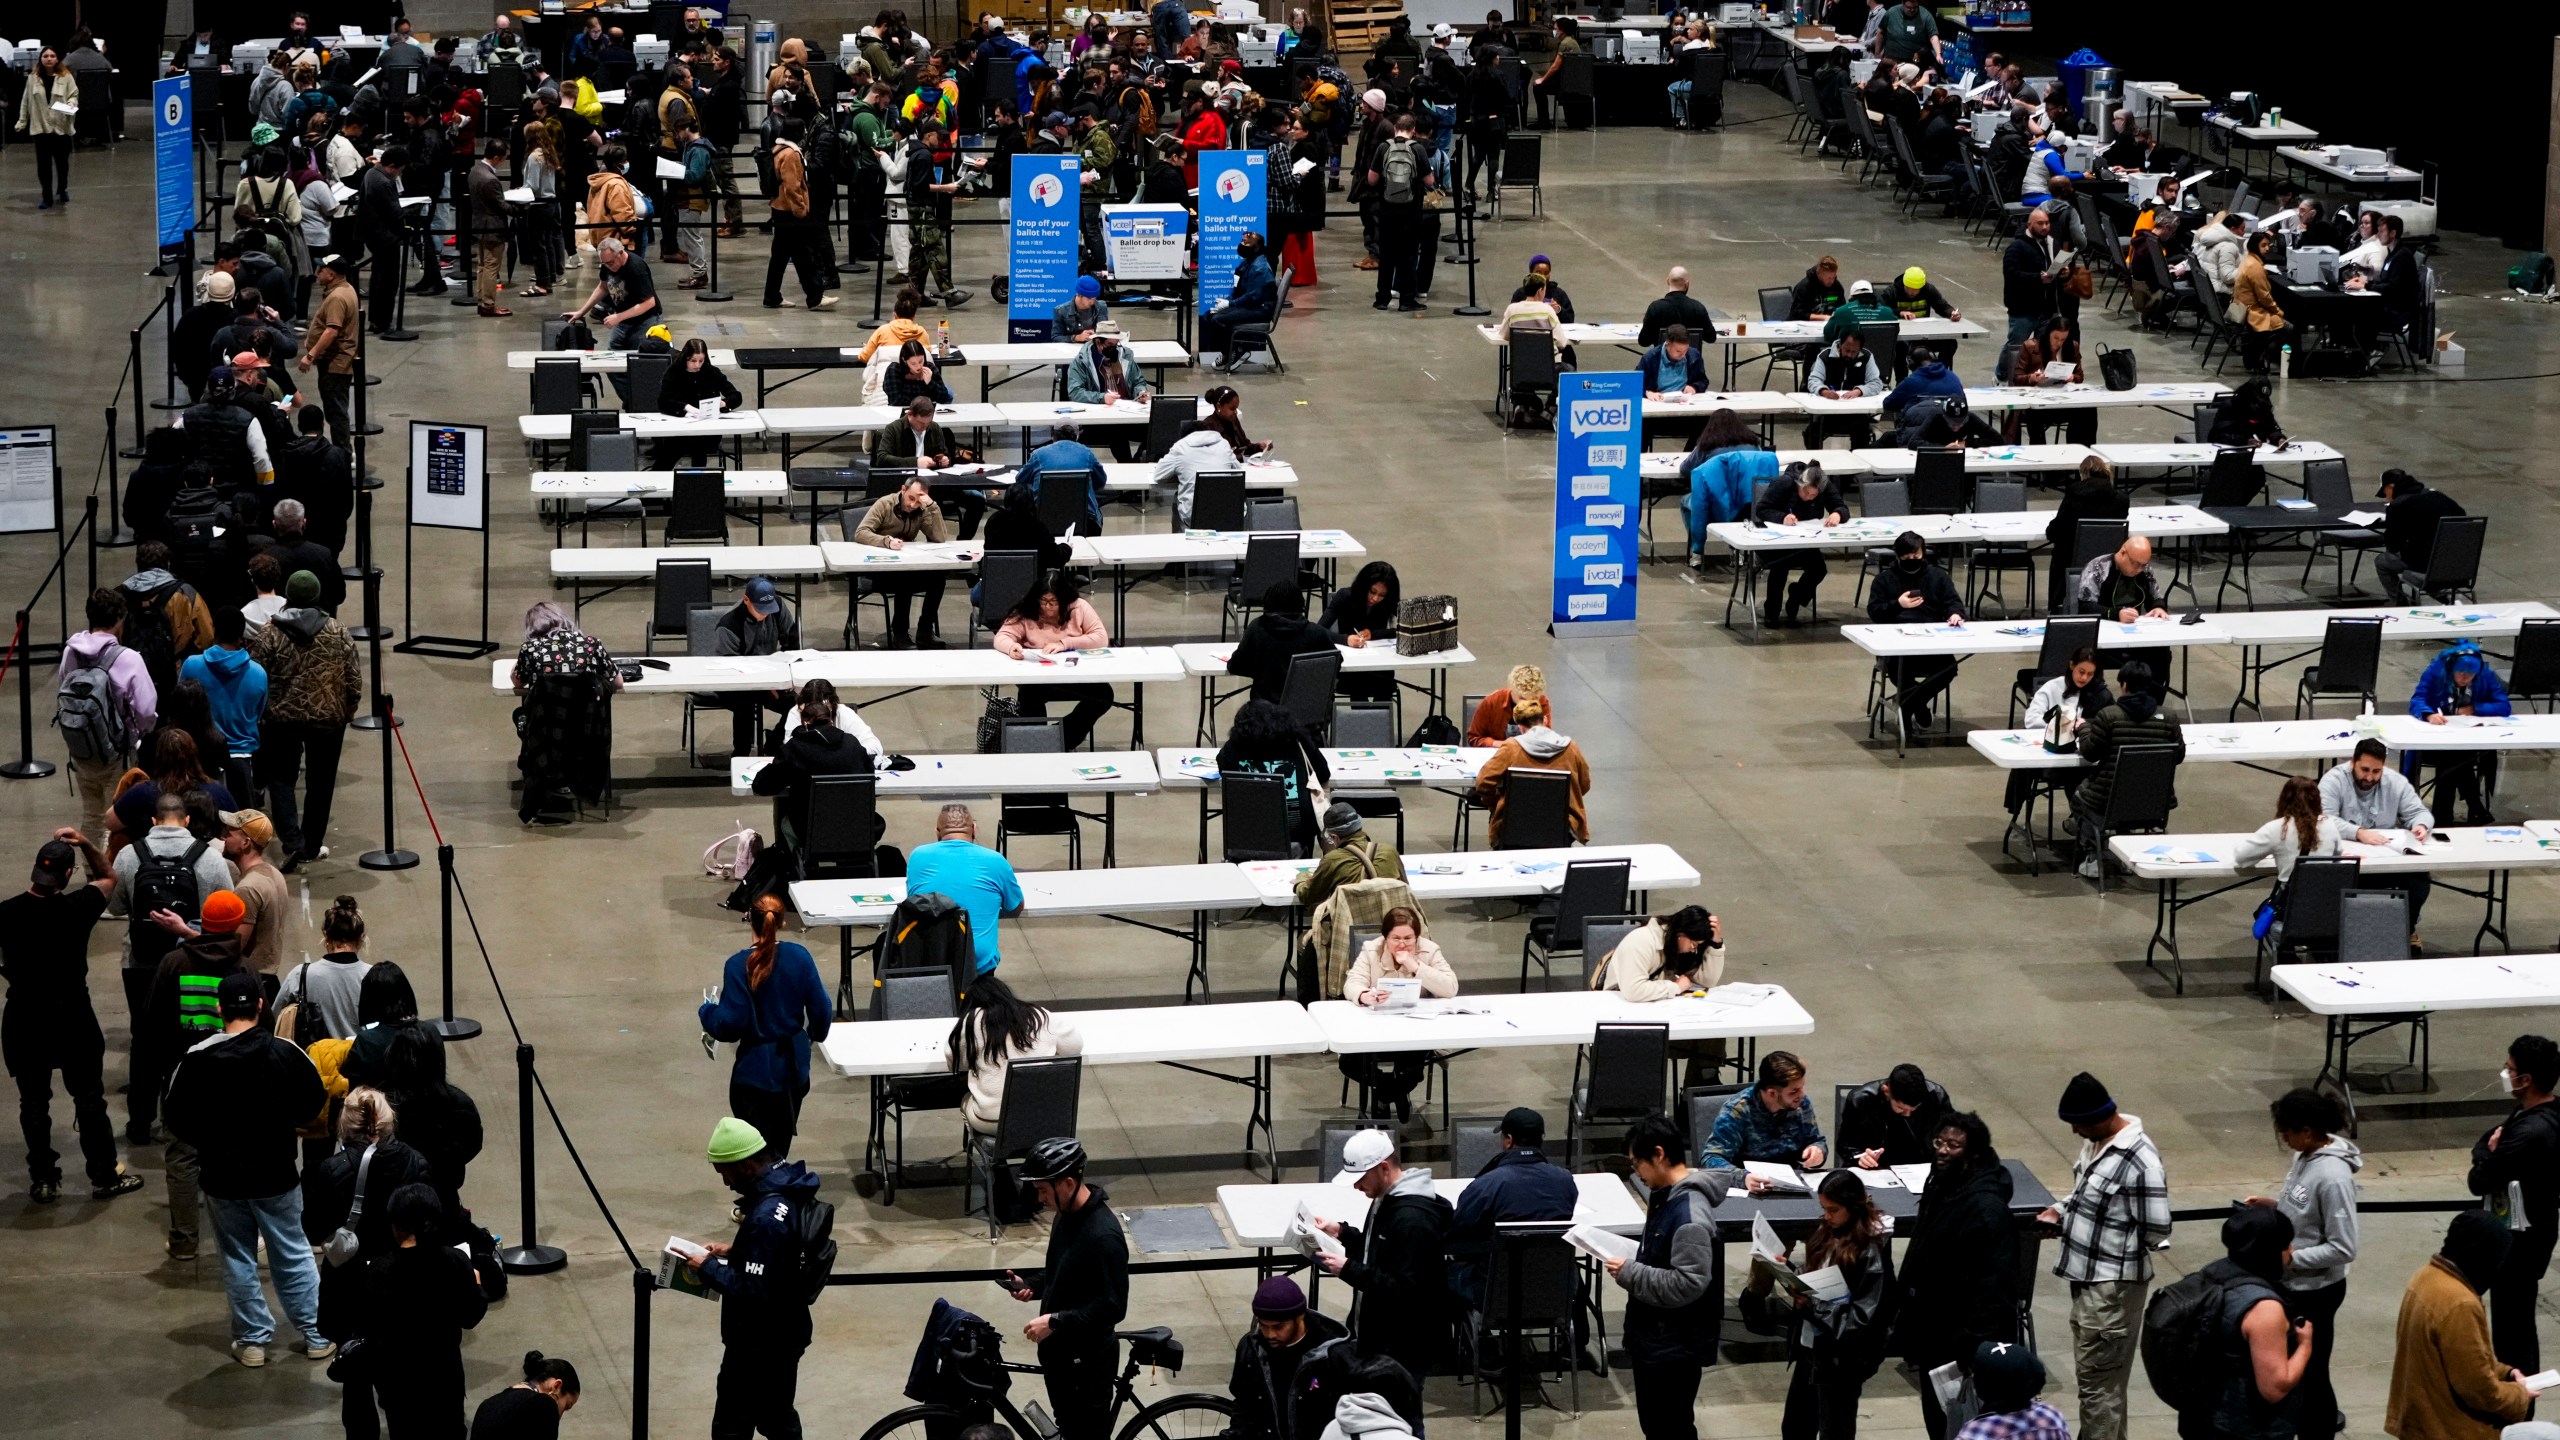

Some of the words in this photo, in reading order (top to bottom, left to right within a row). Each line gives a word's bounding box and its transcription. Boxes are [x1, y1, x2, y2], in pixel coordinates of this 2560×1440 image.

[170, 104, 177, 120] B
[1017, 220, 1036, 228] Drop
[1204, 216, 1224, 224] Drop
[1574, 404, 1627, 426] vote!
[1592, 450, 1622, 463] 投票!
[1589, 510, 1622, 520] голосуй!
[1572, 541, 1606, 551] codeyn!
[1588, 569, 1619, 580] ¡vota!
[774, 1202, 789, 1222] HH
[745, 1261, 764, 1275] HH
